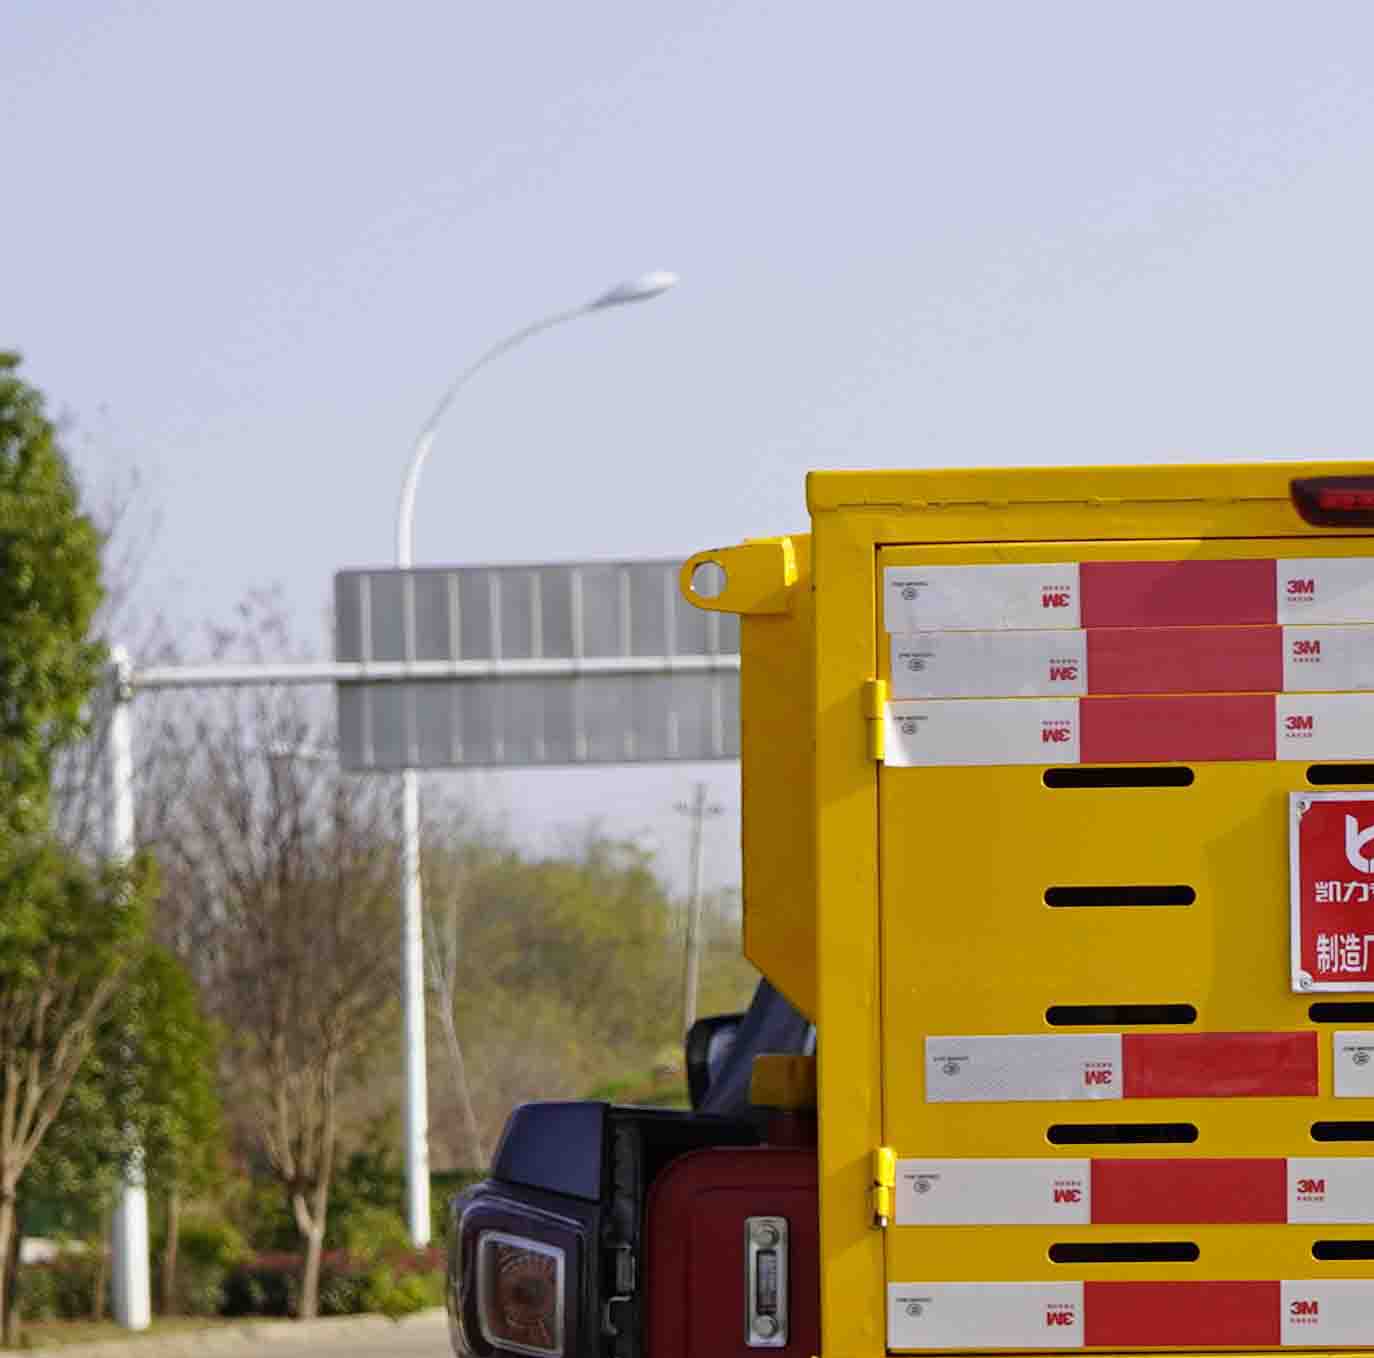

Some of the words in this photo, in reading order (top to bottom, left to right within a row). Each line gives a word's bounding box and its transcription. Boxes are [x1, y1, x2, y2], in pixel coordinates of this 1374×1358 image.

[1289, 581, 1313, 593] 3M
[1042, 592, 1070, 607] 3M
[1294, 640, 1320, 657] 3M
[1049, 667, 1077, 680] 3M
[1287, 715, 1312, 730] 3M
[1041, 727, 1070, 743] 3M
[1084, 1071, 1112, 1087] 3M
[1297, 1179, 1324, 1194] 3M
[1053, 1188, 1081, 1203] 3M
[1291, 1300, 1319, 1316] 3M
[1045, 1311, 1072, 1326] 3M
